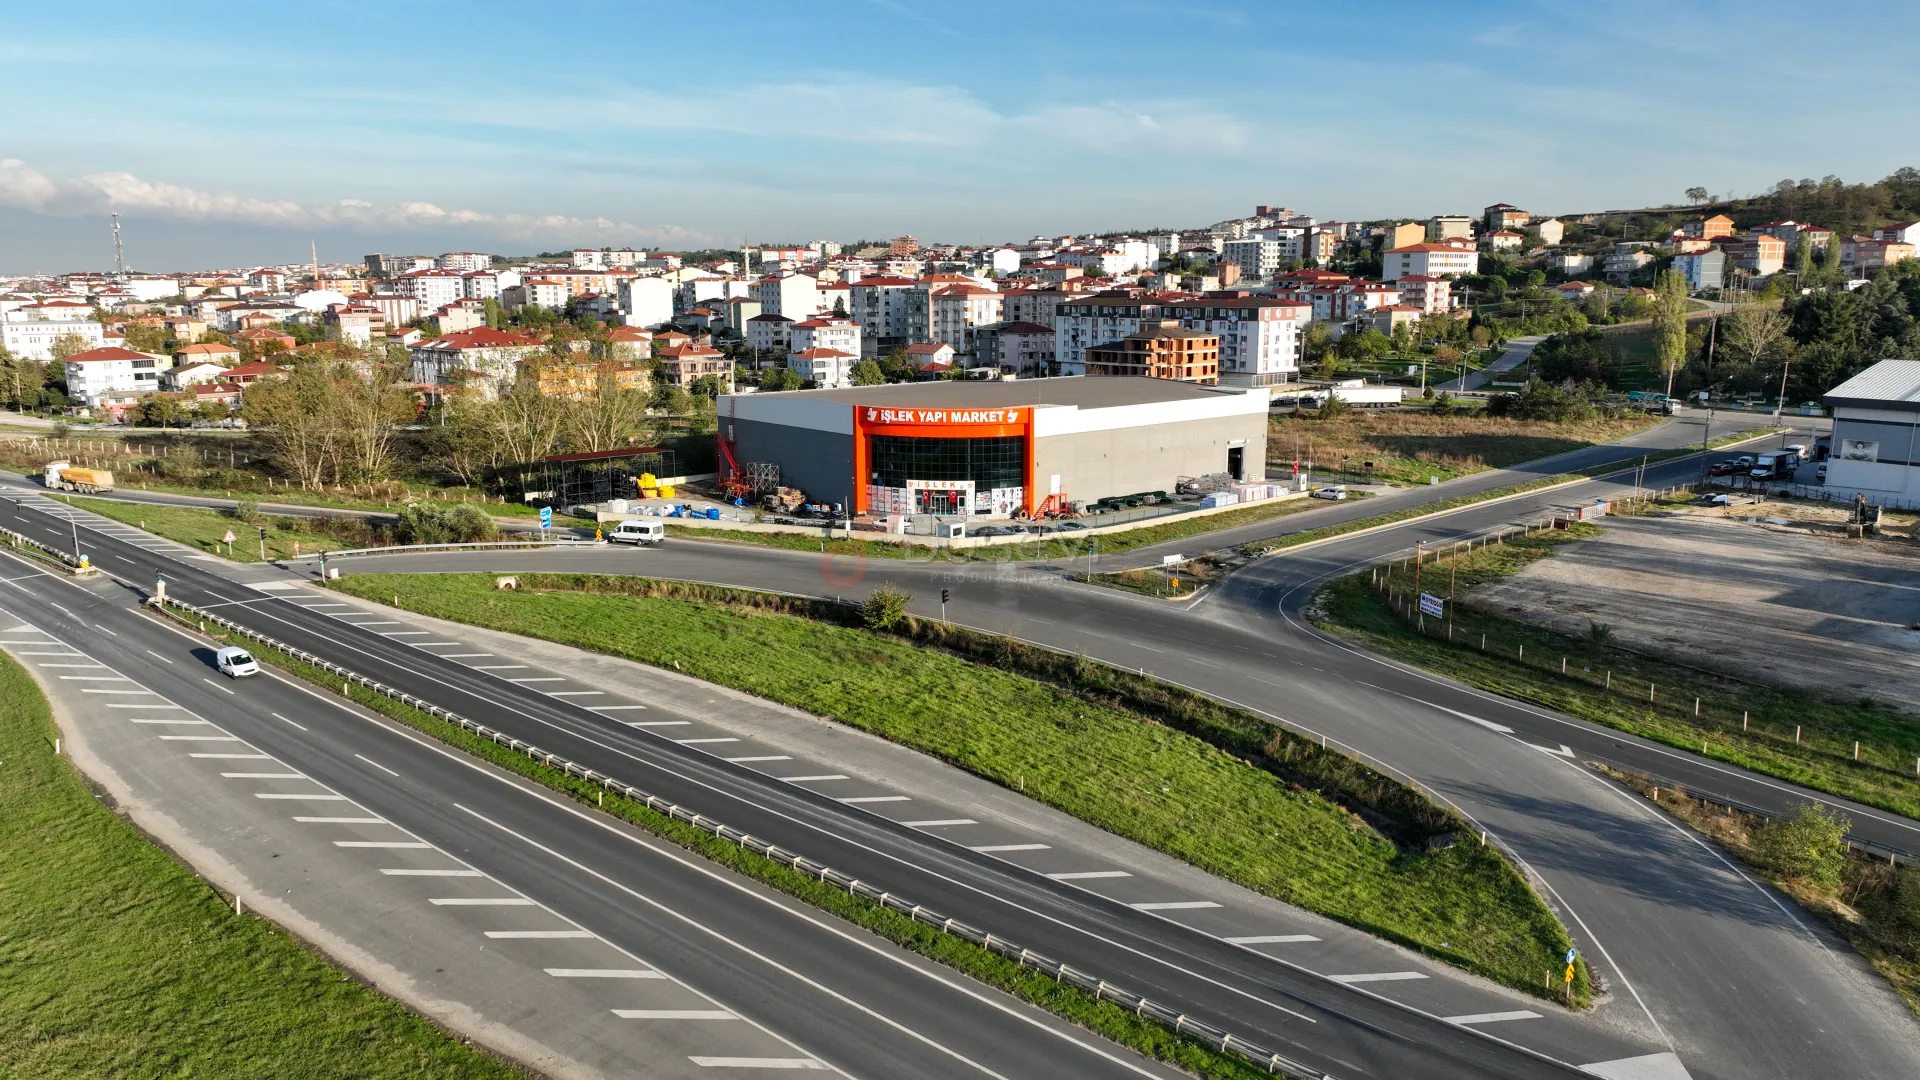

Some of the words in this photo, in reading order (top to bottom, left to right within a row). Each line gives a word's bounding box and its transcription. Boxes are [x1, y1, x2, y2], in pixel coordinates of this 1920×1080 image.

[880, 409, 915, 424] İŞLEK
[917, 411, 947, 423] YAPI
[950, 410, 1005, 423] MARKET
[916, 481, 956, 489] İŞLEK
